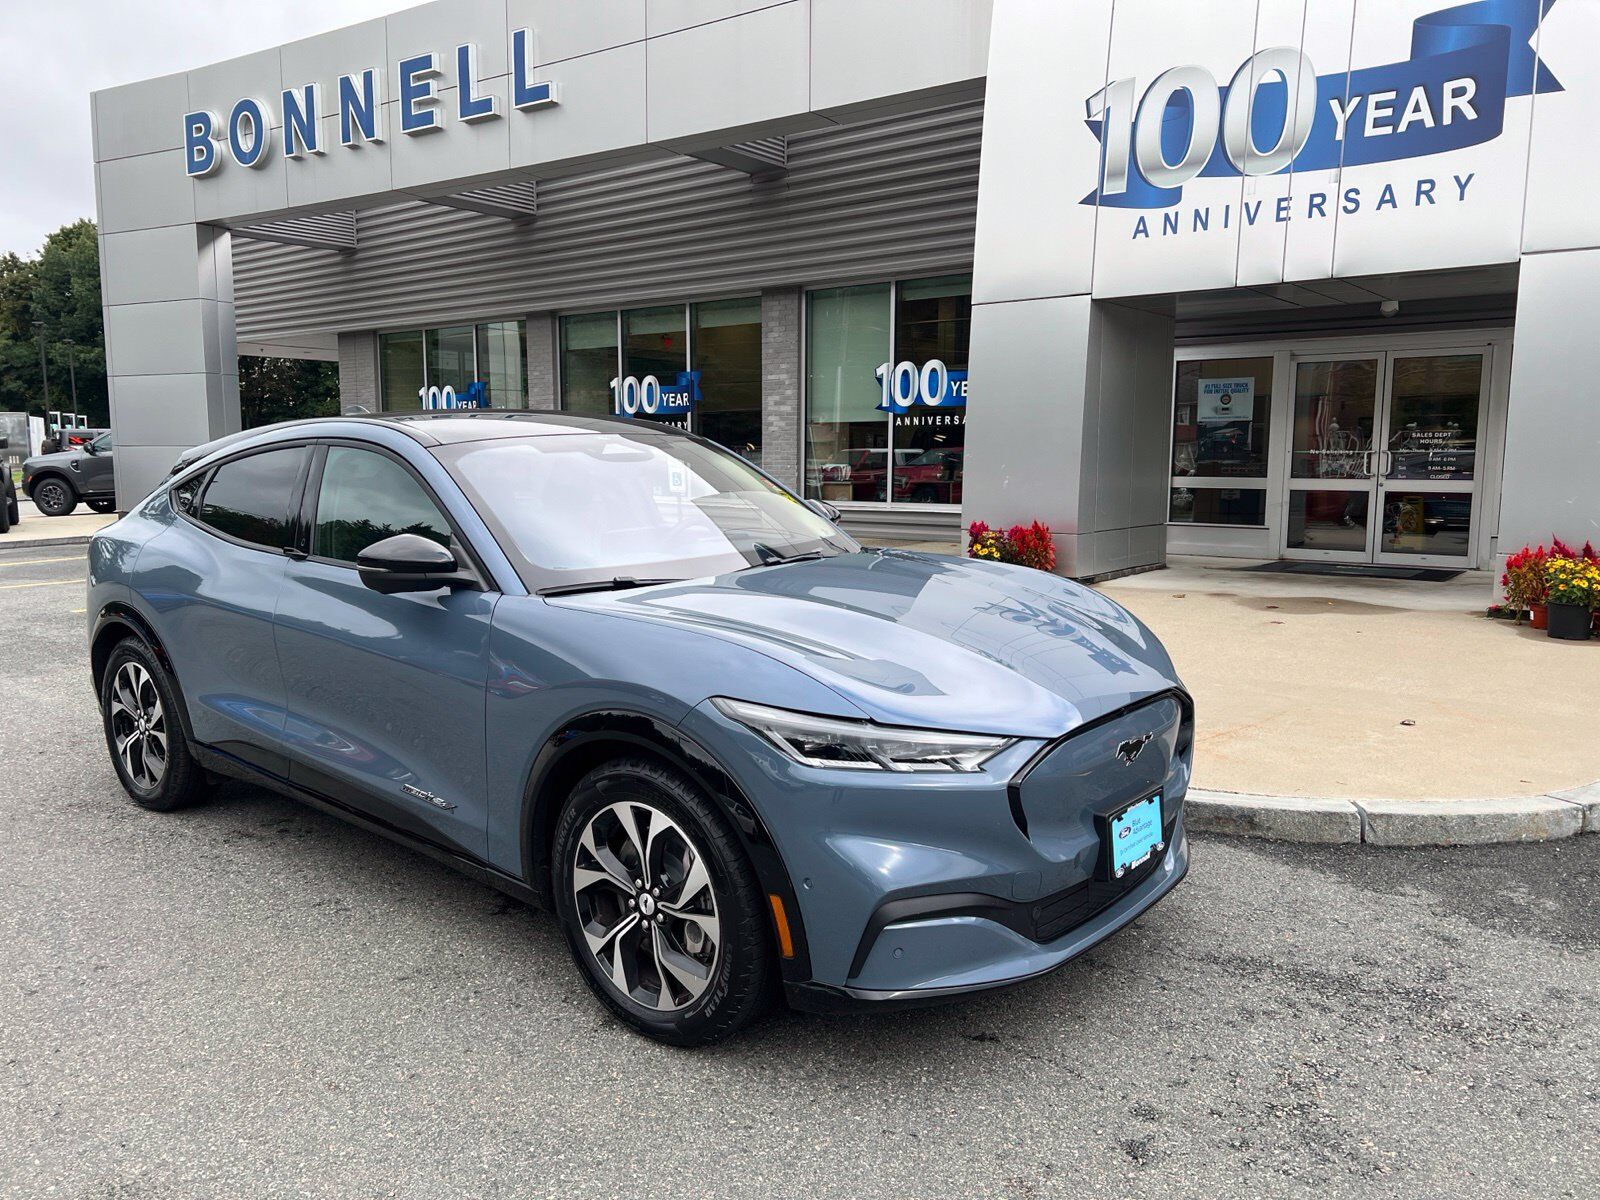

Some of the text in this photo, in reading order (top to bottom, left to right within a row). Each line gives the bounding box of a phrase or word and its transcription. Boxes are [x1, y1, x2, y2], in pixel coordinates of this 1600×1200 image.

[183, 27, 560, 178] BONNELL
[1086, 45, 1479, 196] 100 YEAR
[1131, 172, 1476, 240] ANNIVERSARY
[418, 385, 456, 410] 100
[609, 374, 690, 415] 100 YEAR
[875, 358, 948, 407] 100
